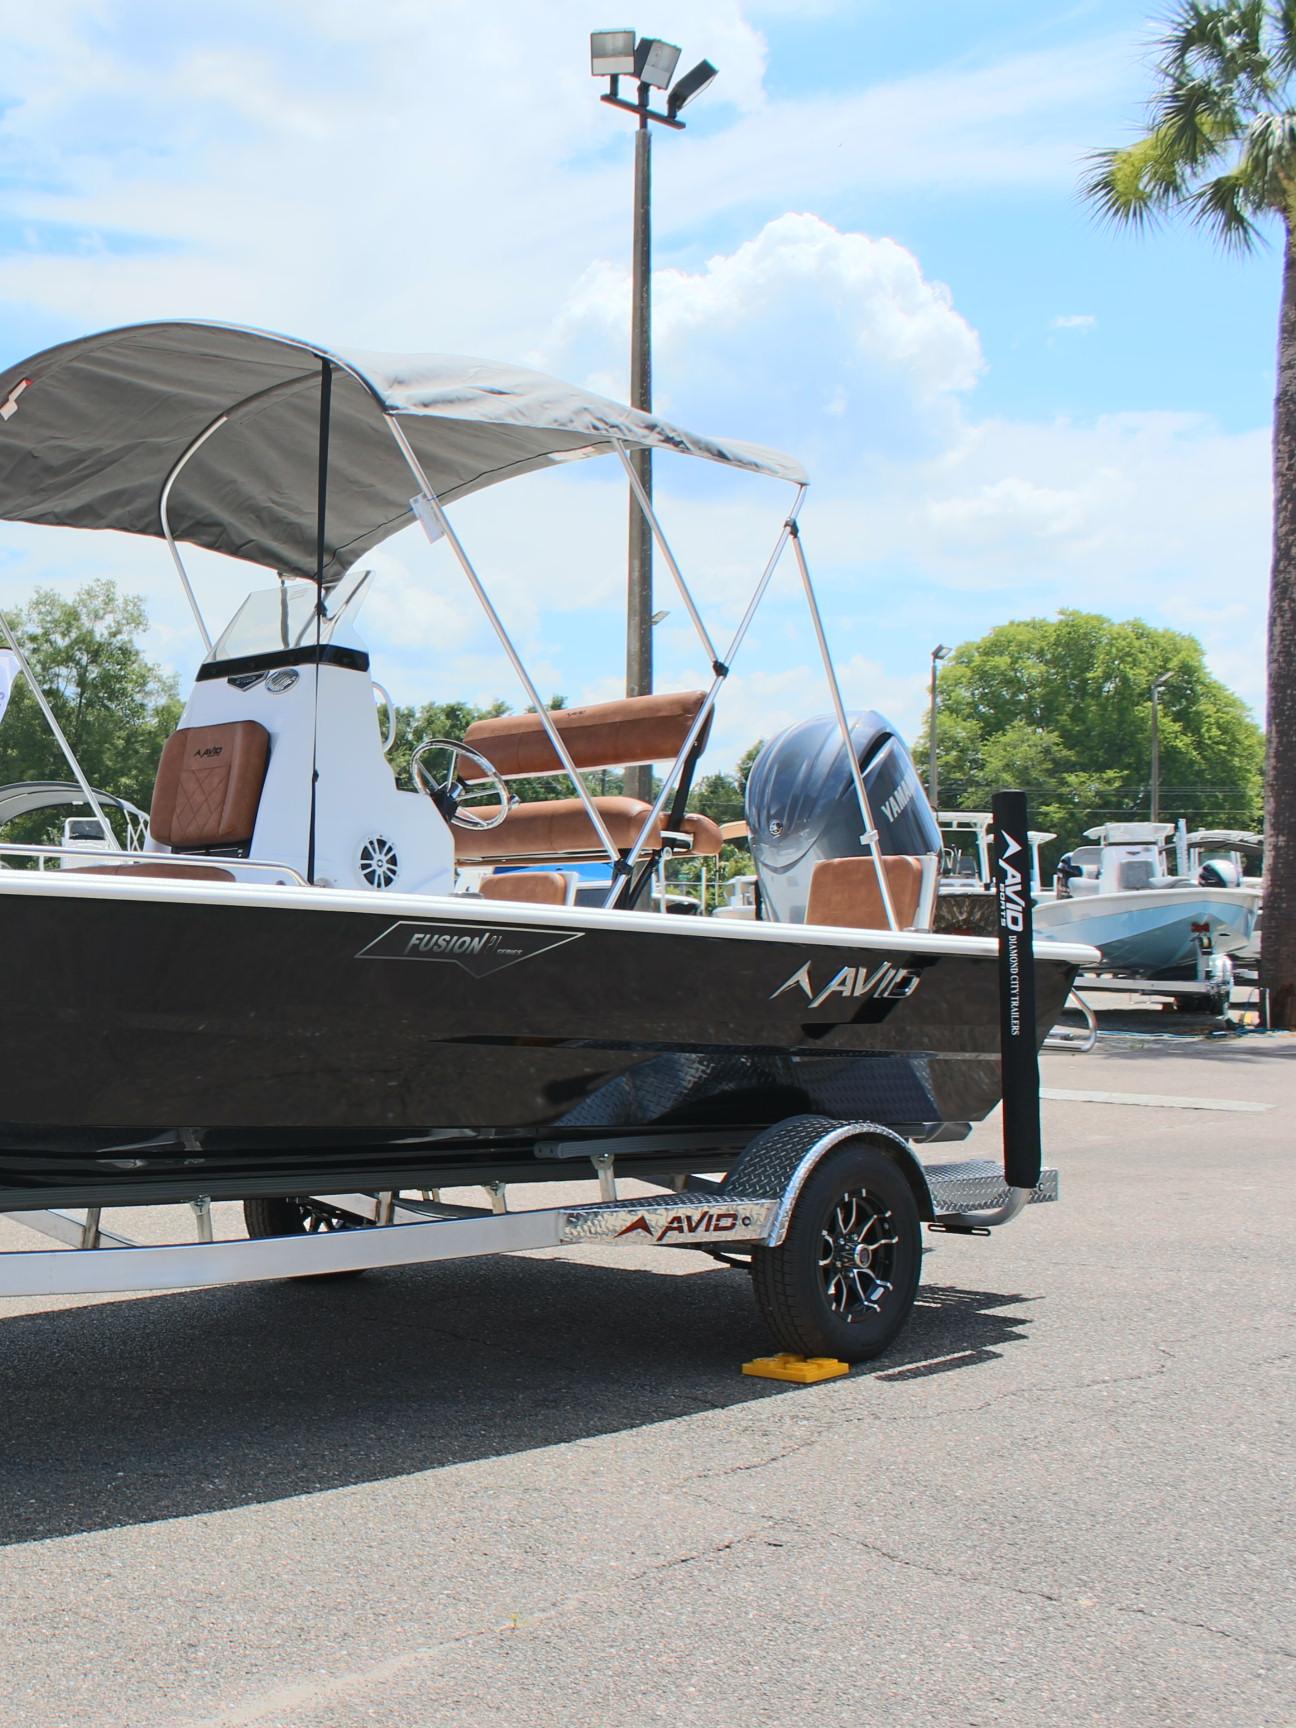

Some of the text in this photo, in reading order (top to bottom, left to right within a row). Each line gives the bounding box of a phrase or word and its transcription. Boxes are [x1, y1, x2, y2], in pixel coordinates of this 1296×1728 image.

[404, 932, 491, 955] FUSION
[998, 858, 1026, 1036] AVID DIAMOND CITY TRAILERS
[808, 961, 921, 1008] AVID
[656, 1211, 737, 1241] AVID
